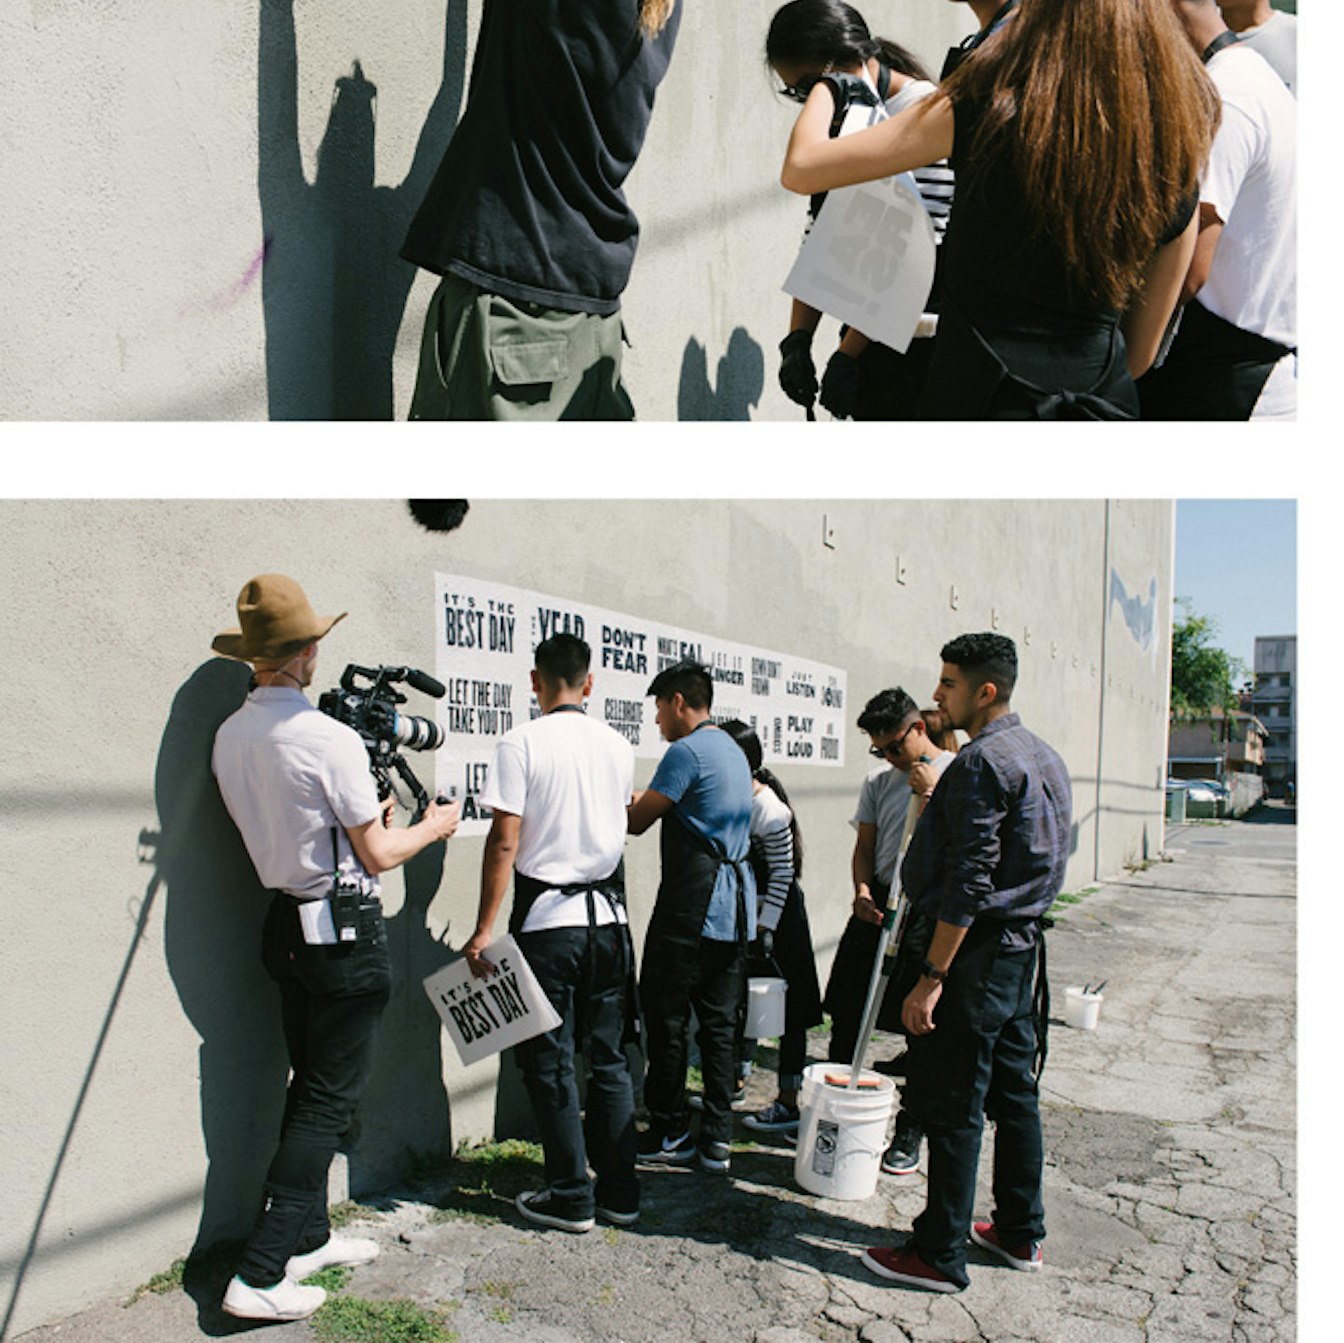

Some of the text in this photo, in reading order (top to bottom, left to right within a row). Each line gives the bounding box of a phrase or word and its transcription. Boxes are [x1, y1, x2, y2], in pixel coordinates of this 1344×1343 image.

[446, 607, 485, 649] BEST
[489, 613, 516, 654] DAY
[602, 625, 647, 652] DON'T
[602, 647, 648, 675] FEAR
[449, 678, 468, 705] LET
[472, 681, 492, 707] THE
[494, 684, 512, 708] DAY
[448, 706, 475, 734] TAKE
[478, 708, 499, 735] YOU
[788, 716, 814, 734] PLAY
[787, 741, 813, 759] LOUD
[448, 972, 530, 1045] BEST DAY
